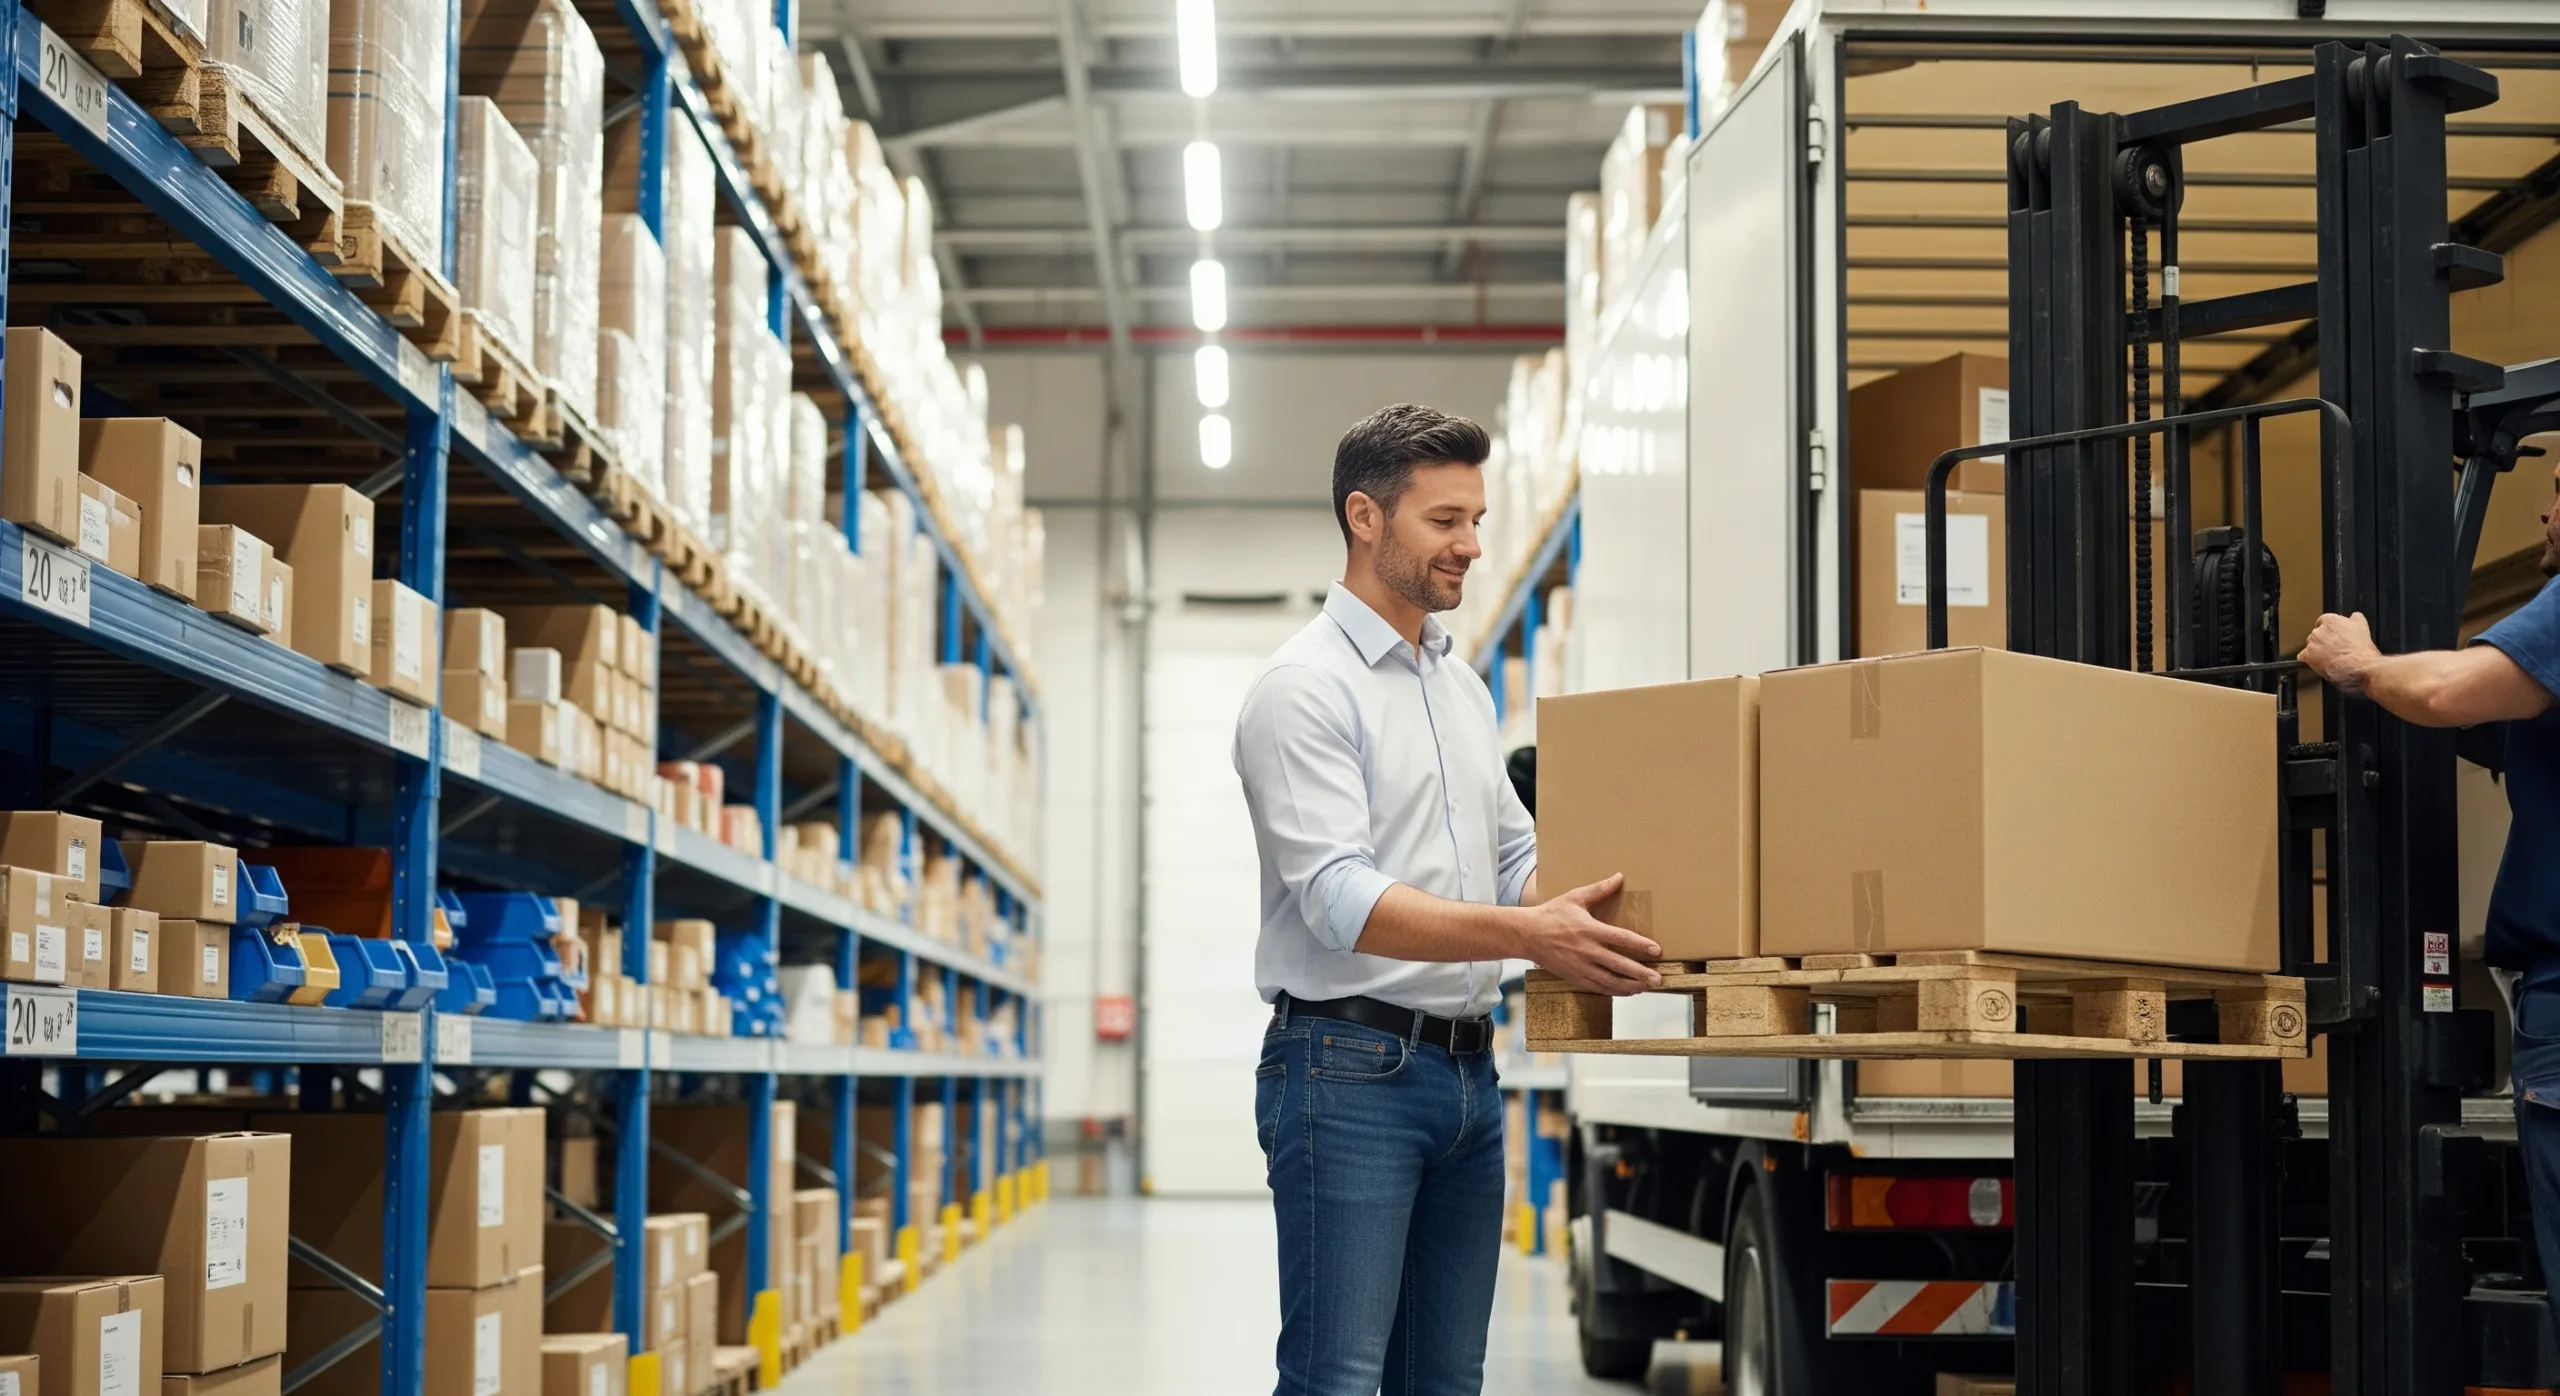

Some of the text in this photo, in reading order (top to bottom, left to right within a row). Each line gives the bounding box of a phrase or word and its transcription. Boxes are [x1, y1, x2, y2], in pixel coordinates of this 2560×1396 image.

[45, 43, 68, 99] 20
[28, 547, 51, 602] 20
[12, 997, 36, 1046] 20
